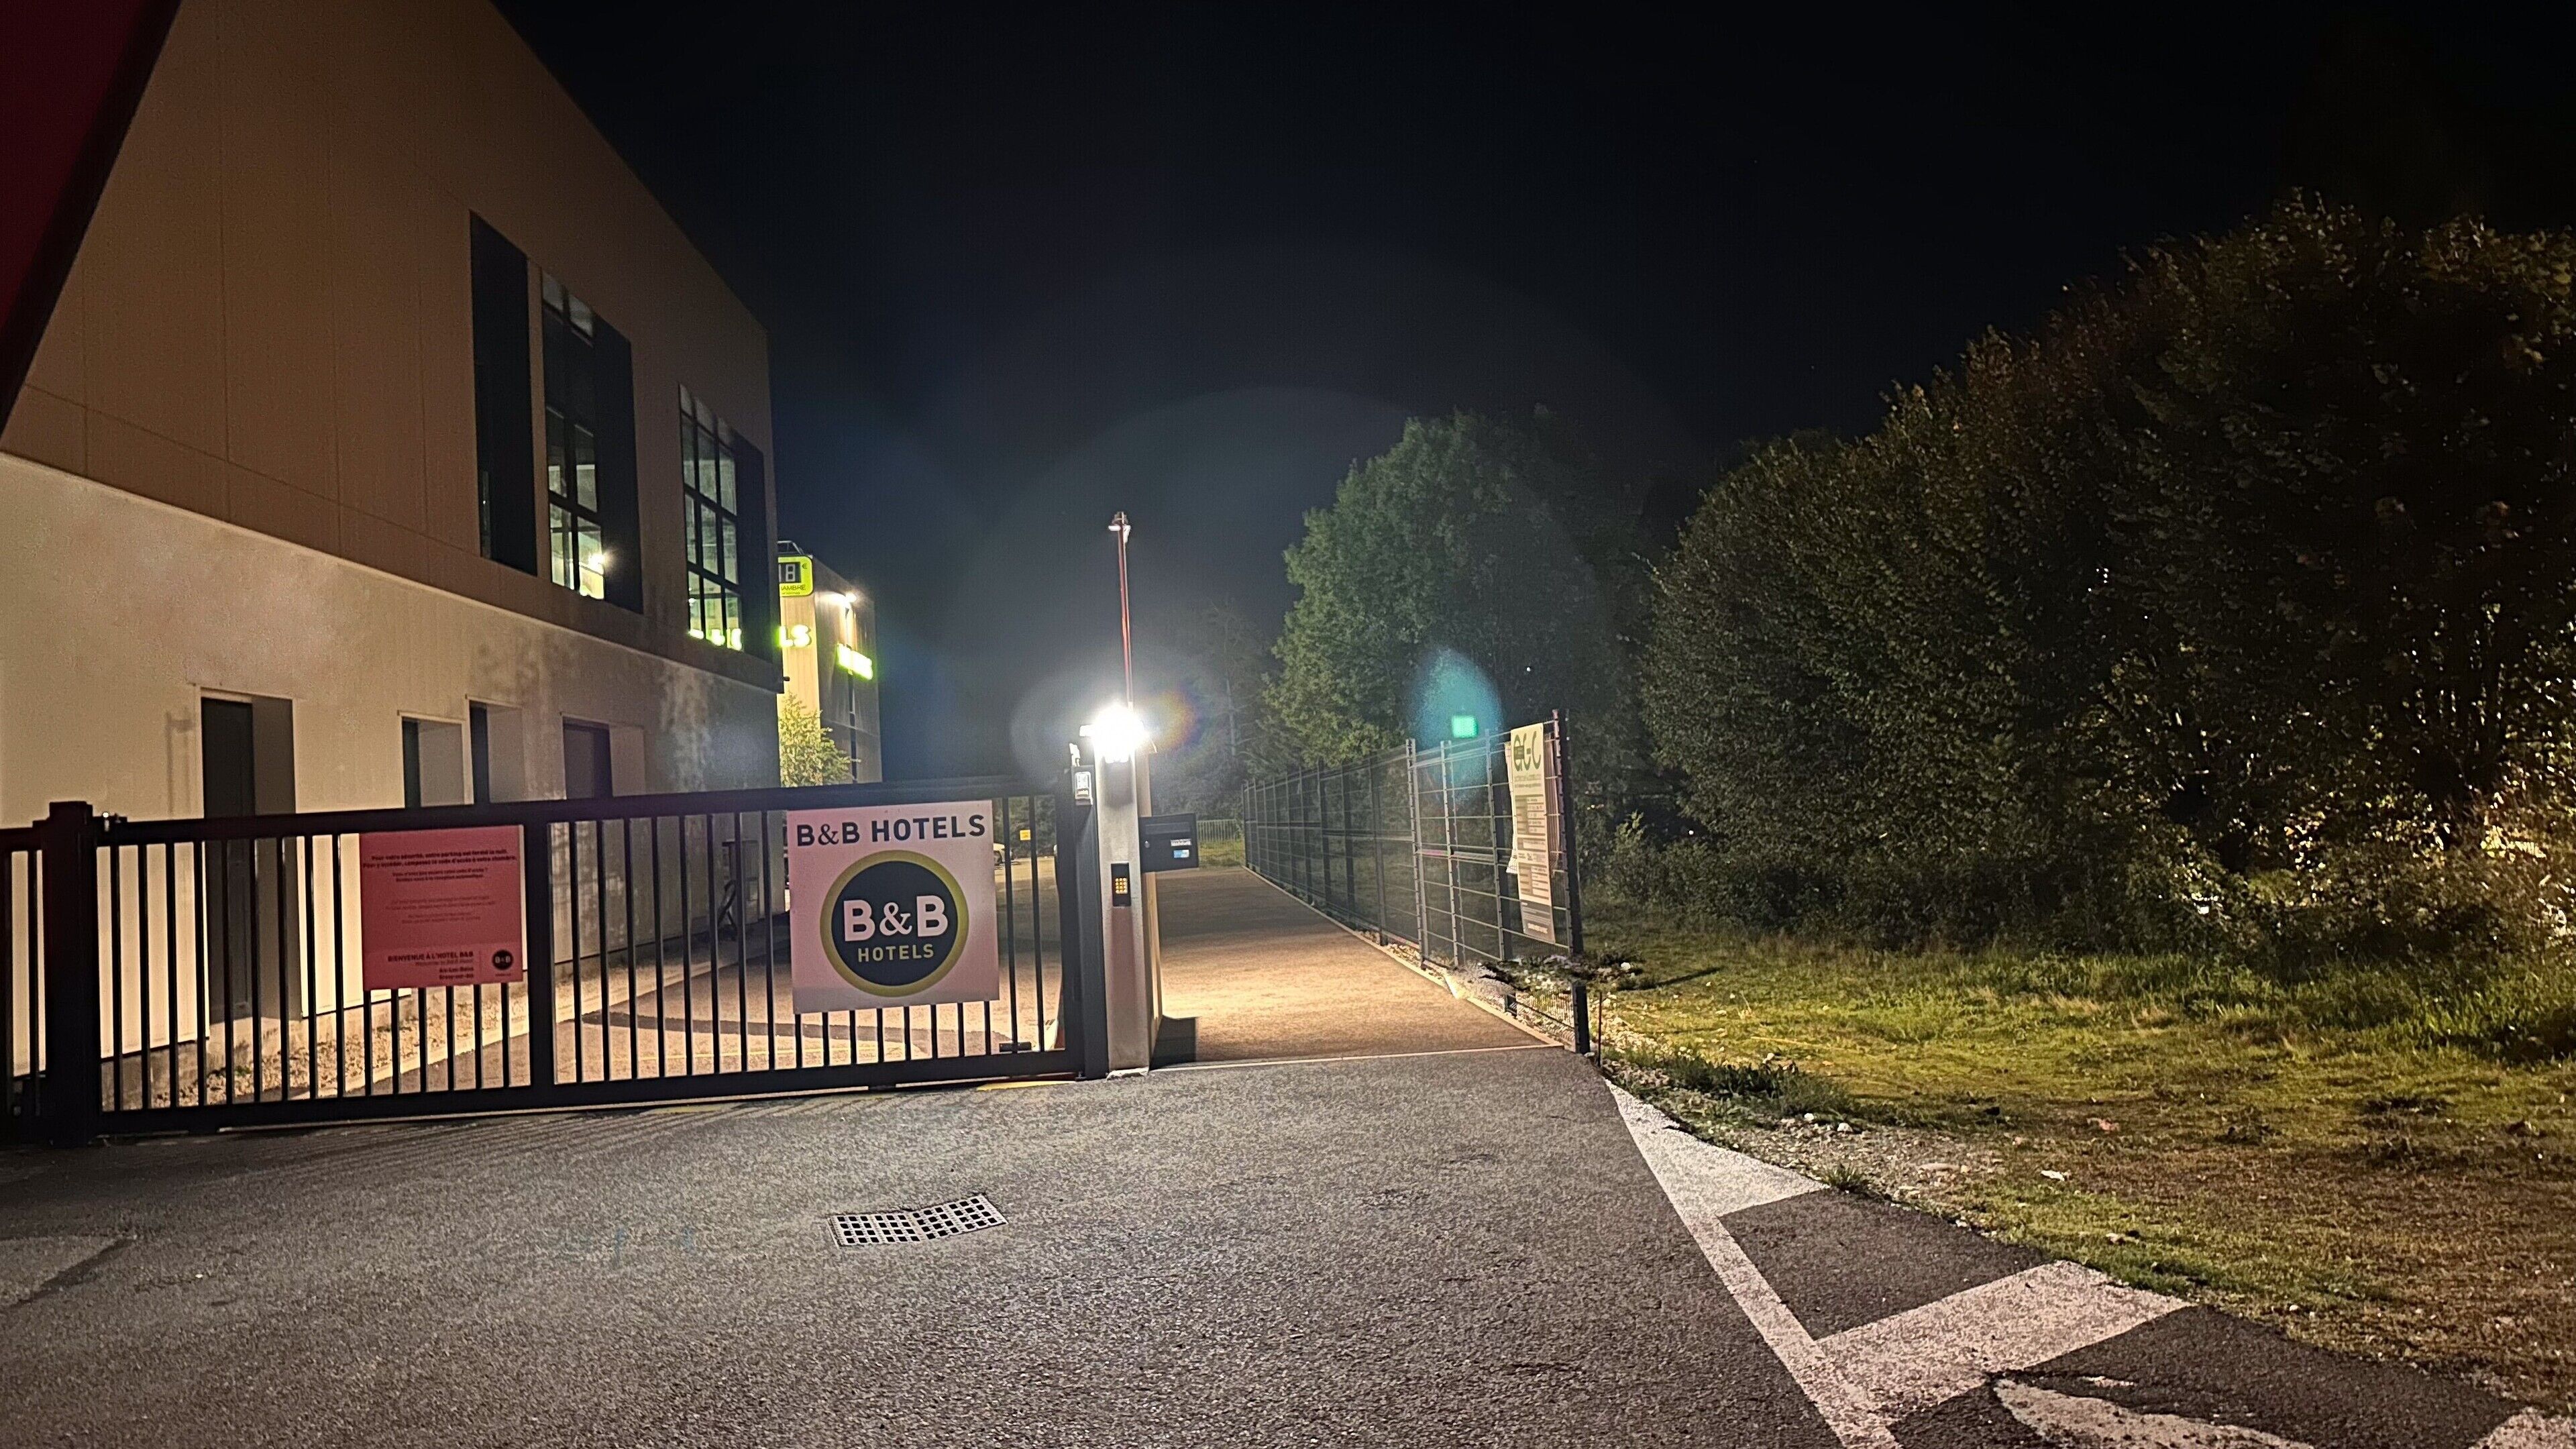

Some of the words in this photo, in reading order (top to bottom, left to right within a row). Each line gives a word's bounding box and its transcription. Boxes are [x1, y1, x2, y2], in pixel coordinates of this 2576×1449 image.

[796, 822, 860, 847] B&B
[871, 814, 985, 843] HOTELS
[843, 895, 949, 942] B&B
[857, 943, 934, 963] HOTELS
